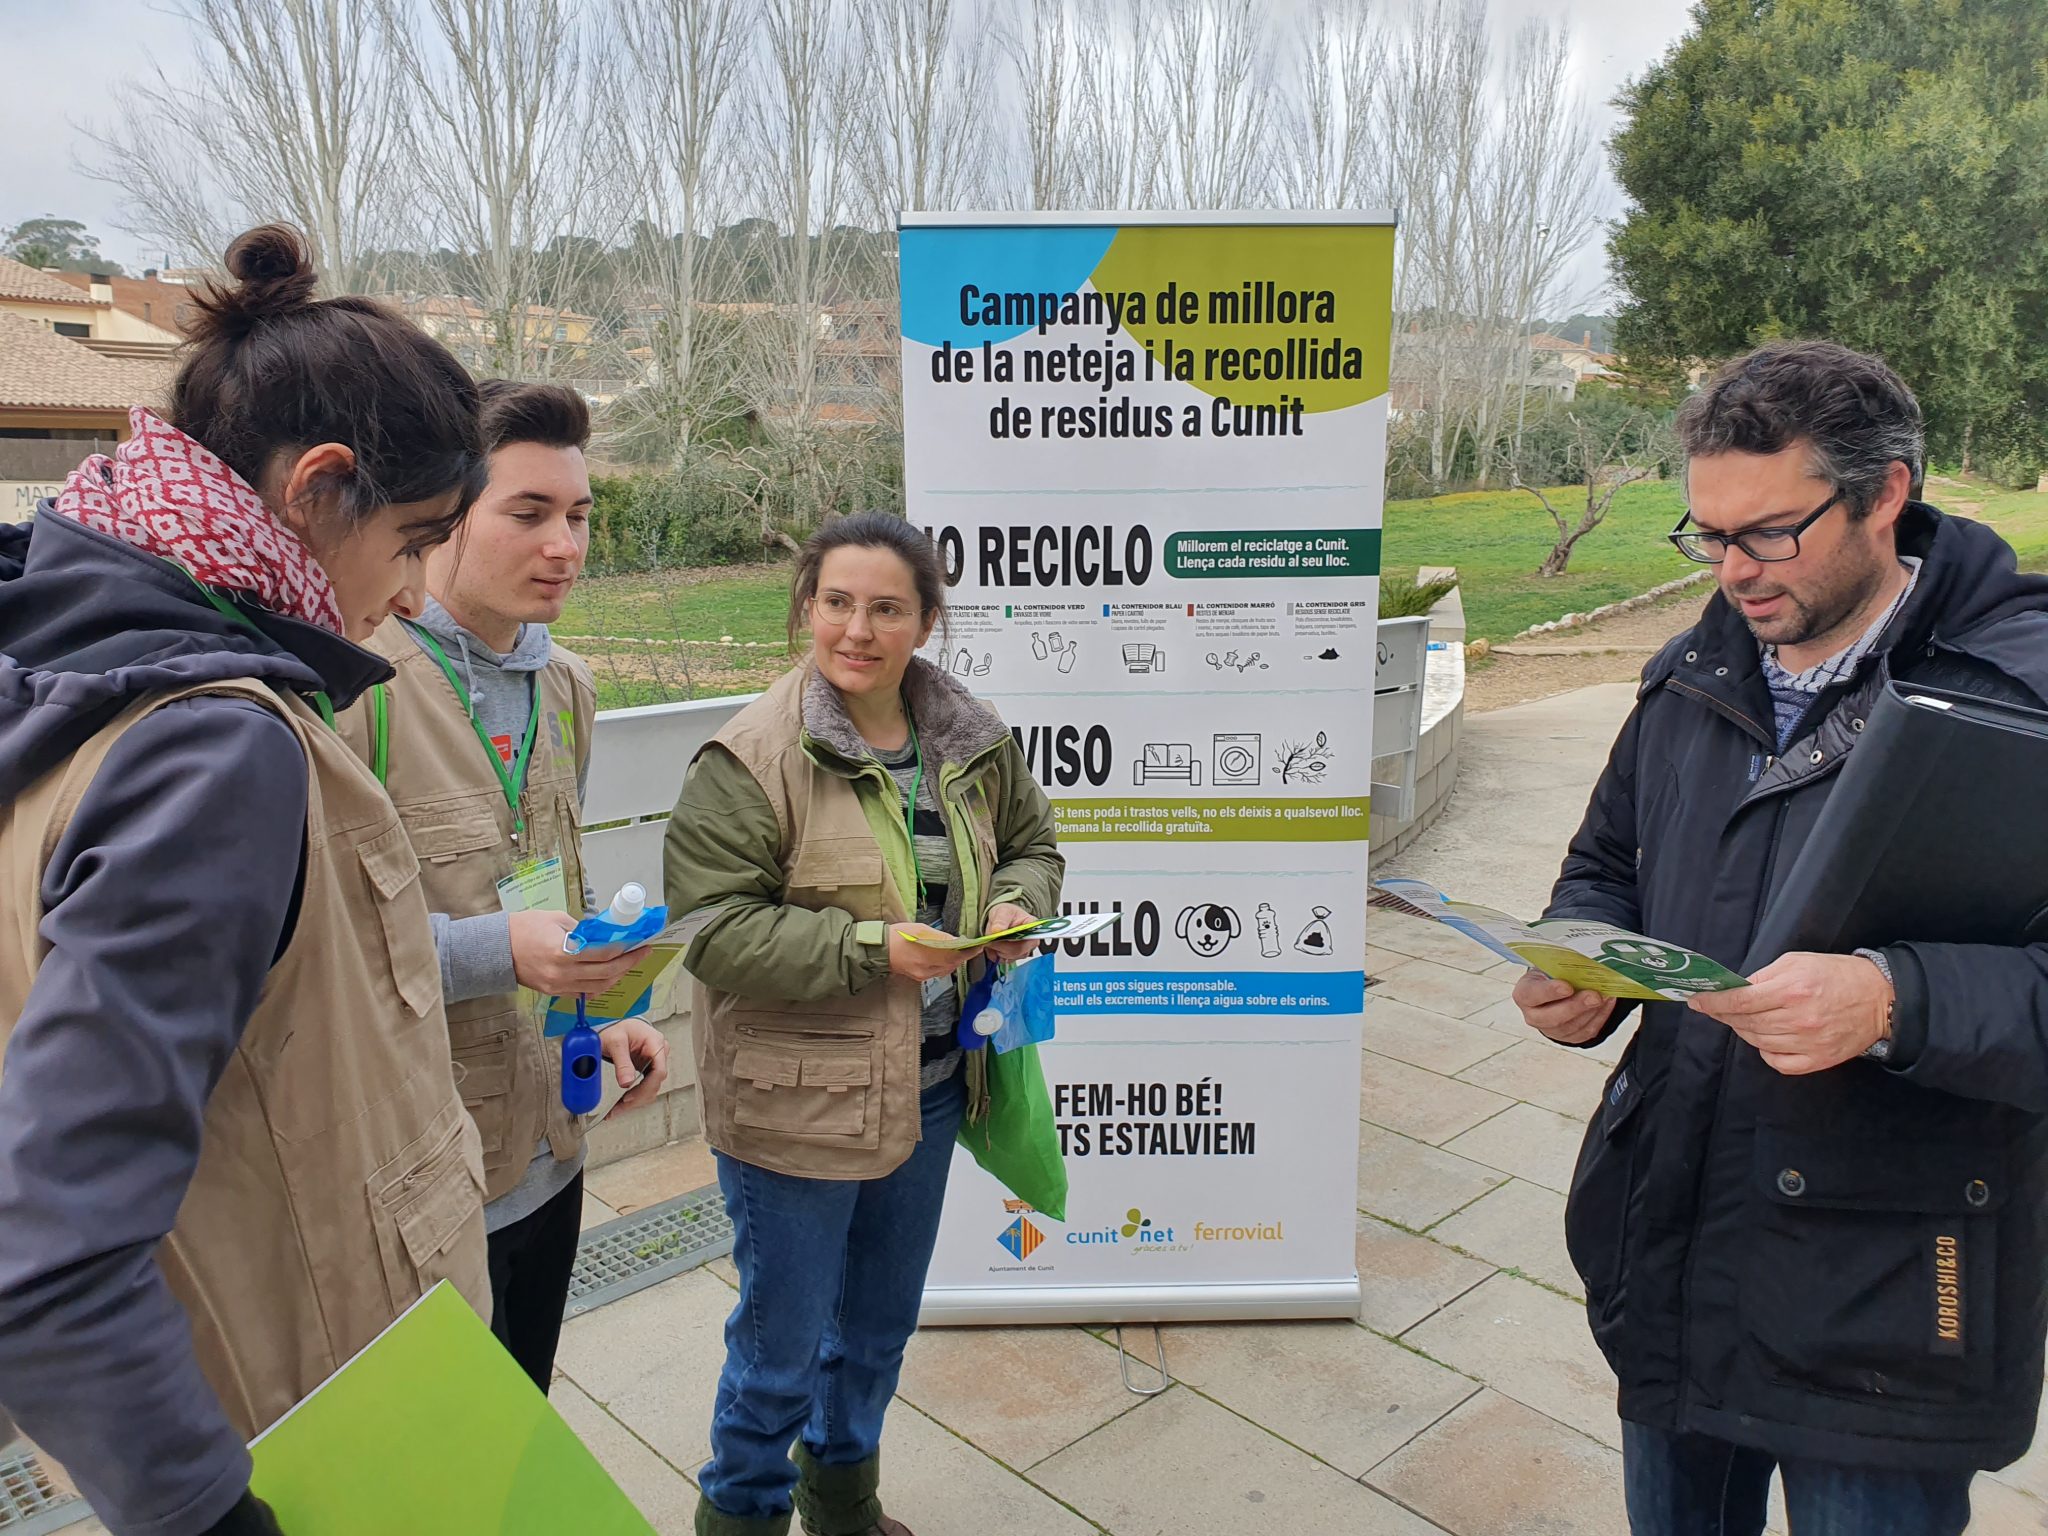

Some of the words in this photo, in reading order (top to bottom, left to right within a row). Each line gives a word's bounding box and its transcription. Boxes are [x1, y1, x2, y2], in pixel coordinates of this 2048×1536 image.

[960, 283, 1146, 335] Campanya
[1156, 282, 1199, 324] de
[1208, 281, 1335, 324] millora
[932, 341, 974, 383] de
[984, 341, 1014, 383] la
[1024, 340, 1135, 391] neteja
[1145, 340, 1155, 382] i
[1164, 339, 1195, 381] la
[1205, 338, 1363, 380] recollida
[990, 397, 1032, 439] de
[1042, 397, 1173, 439] residus
[1183, 406, 1201, 438] a
[1211, 395, 1304, 436] Cunit
[978, 524, 1153, 588] RECICLO
[1177, 540, 1228, 553] Millorem
[1231, 539, 1242, 552] el
[1244, 539, 1303, 554] reciclatge
[1305, 541, 1312, 551] a
[1315, 538, 1349, 551] Cunit.
[1177, 556, 1215, 571] Llença
[1218, 555, 1246, 568] cada
[1249, 555, 1286, 568] residu
[1288, 554, 1299, 567] al
[1302, 556, 1323, 567] seu
[1326, 554, 1350, 567] lloc.
[1011, 724, 1112, 787] VISO
[1054, 806, 1064, 818] Si
[1067, 807, 1091, 818] tens
[1094, 806, 1121, 820] poda
[1130, 806, 1168, 818] trastos
[1171, 806, 1200, 819] vells,
[1203, 808, 1217, 817] no
[1219, 805, 1236, 818] els
[1239, 805, 1272, 818] deixis
[1274, 808, 1281, 817] a
[1284, 805, 1338, 820] qualsevol
[1341, 805, 1364, 817] lloc.
[1055, 822, 1099, 833] Demana
[1102, 821, 1112, 833] la
[1115, 821, 1163, 833] recollida
[1166, 821, 1213, 835] gratuïta.
[1039, 900, 1160, 957] ULLO
[1063, 981, 1087, 992] tens
[1089, 982, 1103, 991] un
[1105, 981, 1126, 993] gos
[1128, 979, 1164, 993] sigues
[1166, 979, 1237, 993] responsable.
[1086, 994, 1102, 1006] els
[1105, 994, 1168, 1006] excrements
[1177, 994, 1210, 1008] llença
[1213, 994, 1243, 1008] aigua
[1246, 993, 1278, 1006] sobre
[1280, 994, 1296, 1006] els
[1299, 994, 1330, 1006] orins.
[1055, 1083, 1167, 1117] FEM-HO
[1176, 1076, 1223, 1116] BÉ!
[1056, 1123, 1091, 1157] TS
[1099, 1122, 1256, 1156] ESTALVIEM
[1066, 1226, 1118, 1244] cunit
[1140, 1227, 1174, 1242] net
[1194, 1222, 1284, 1241] ferrovial
[1936, 1235, 1959, 1340] KOROSHI&CO
